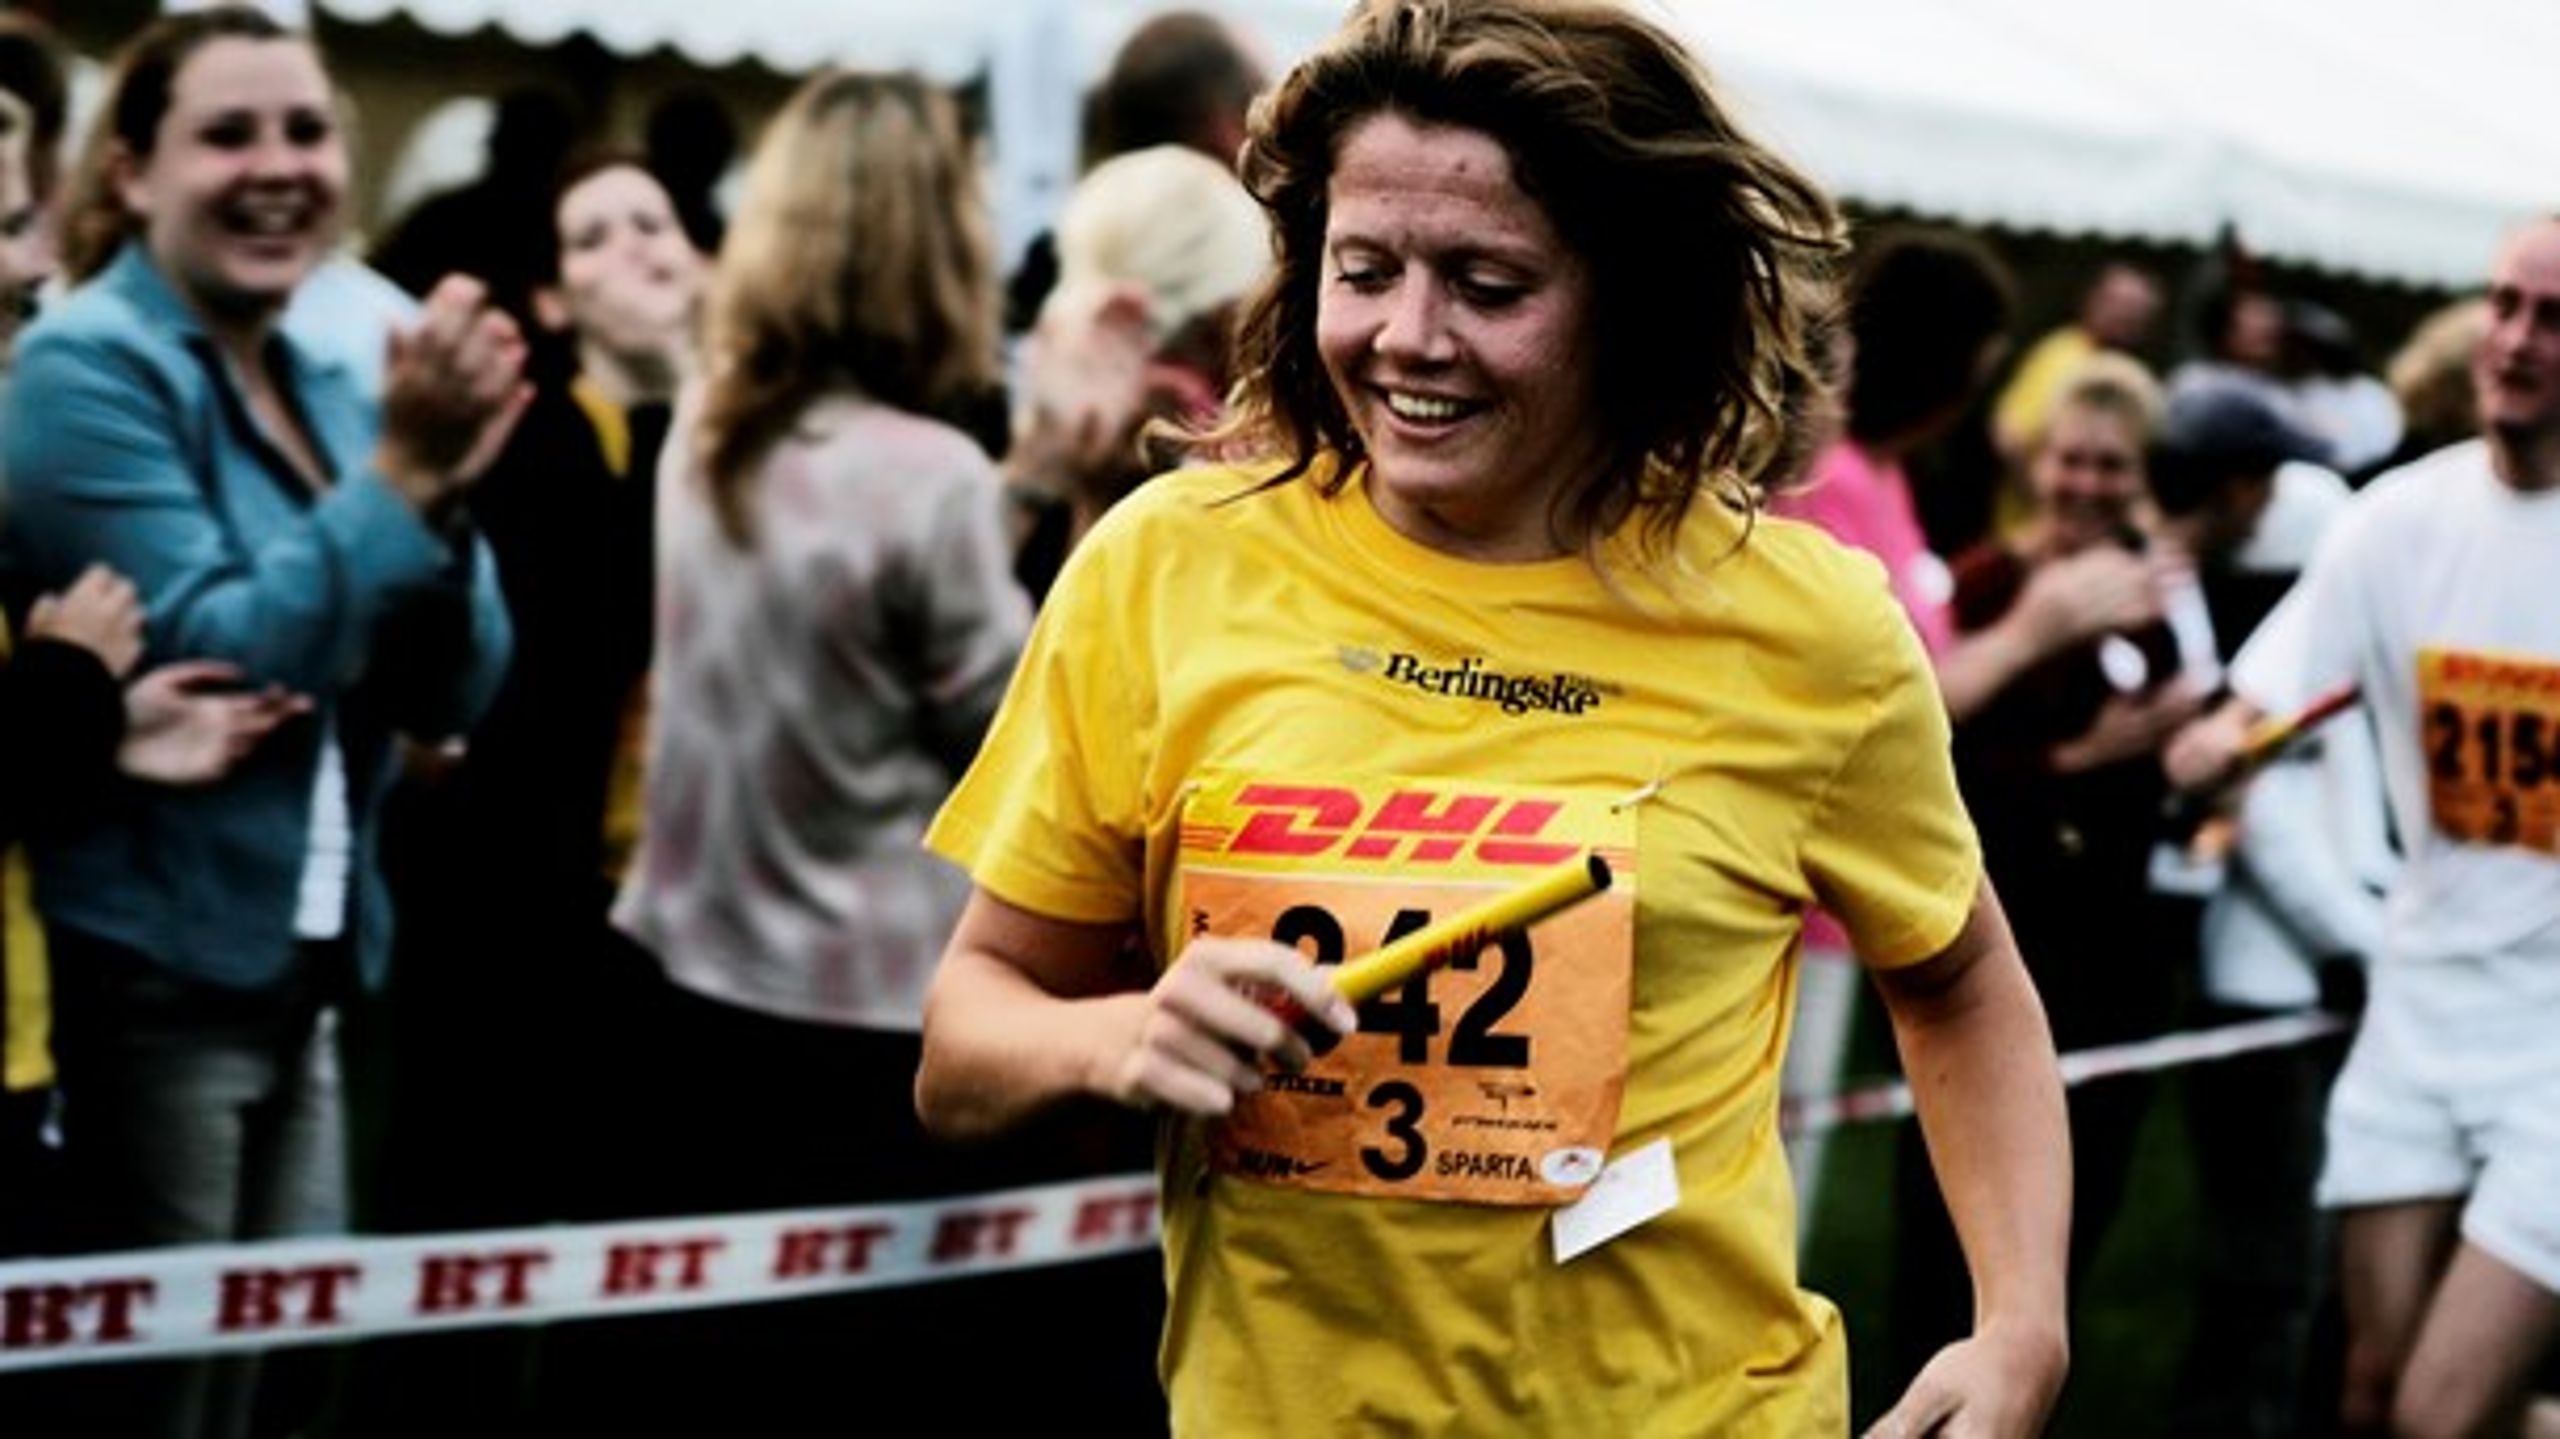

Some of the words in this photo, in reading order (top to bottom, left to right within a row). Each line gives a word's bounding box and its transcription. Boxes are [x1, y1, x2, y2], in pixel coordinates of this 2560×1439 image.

[1384, 652, 1600, 715] Berlingske
[1229, 784, 1579, 864] DHL
[1359, 1080, 1428, 1181] 3
[1435, 1149, 1534, 1182] SPARTA
[0, 1278, 156, 1348] BT
[216, 1264, 362, 1332] BT
[416, 1250, 550, 1315] BT
[602, 1237, 726, 1294] BT
[772, 1222, 893, 1280] BT
[929, 1206, 1037, 1264] BT
